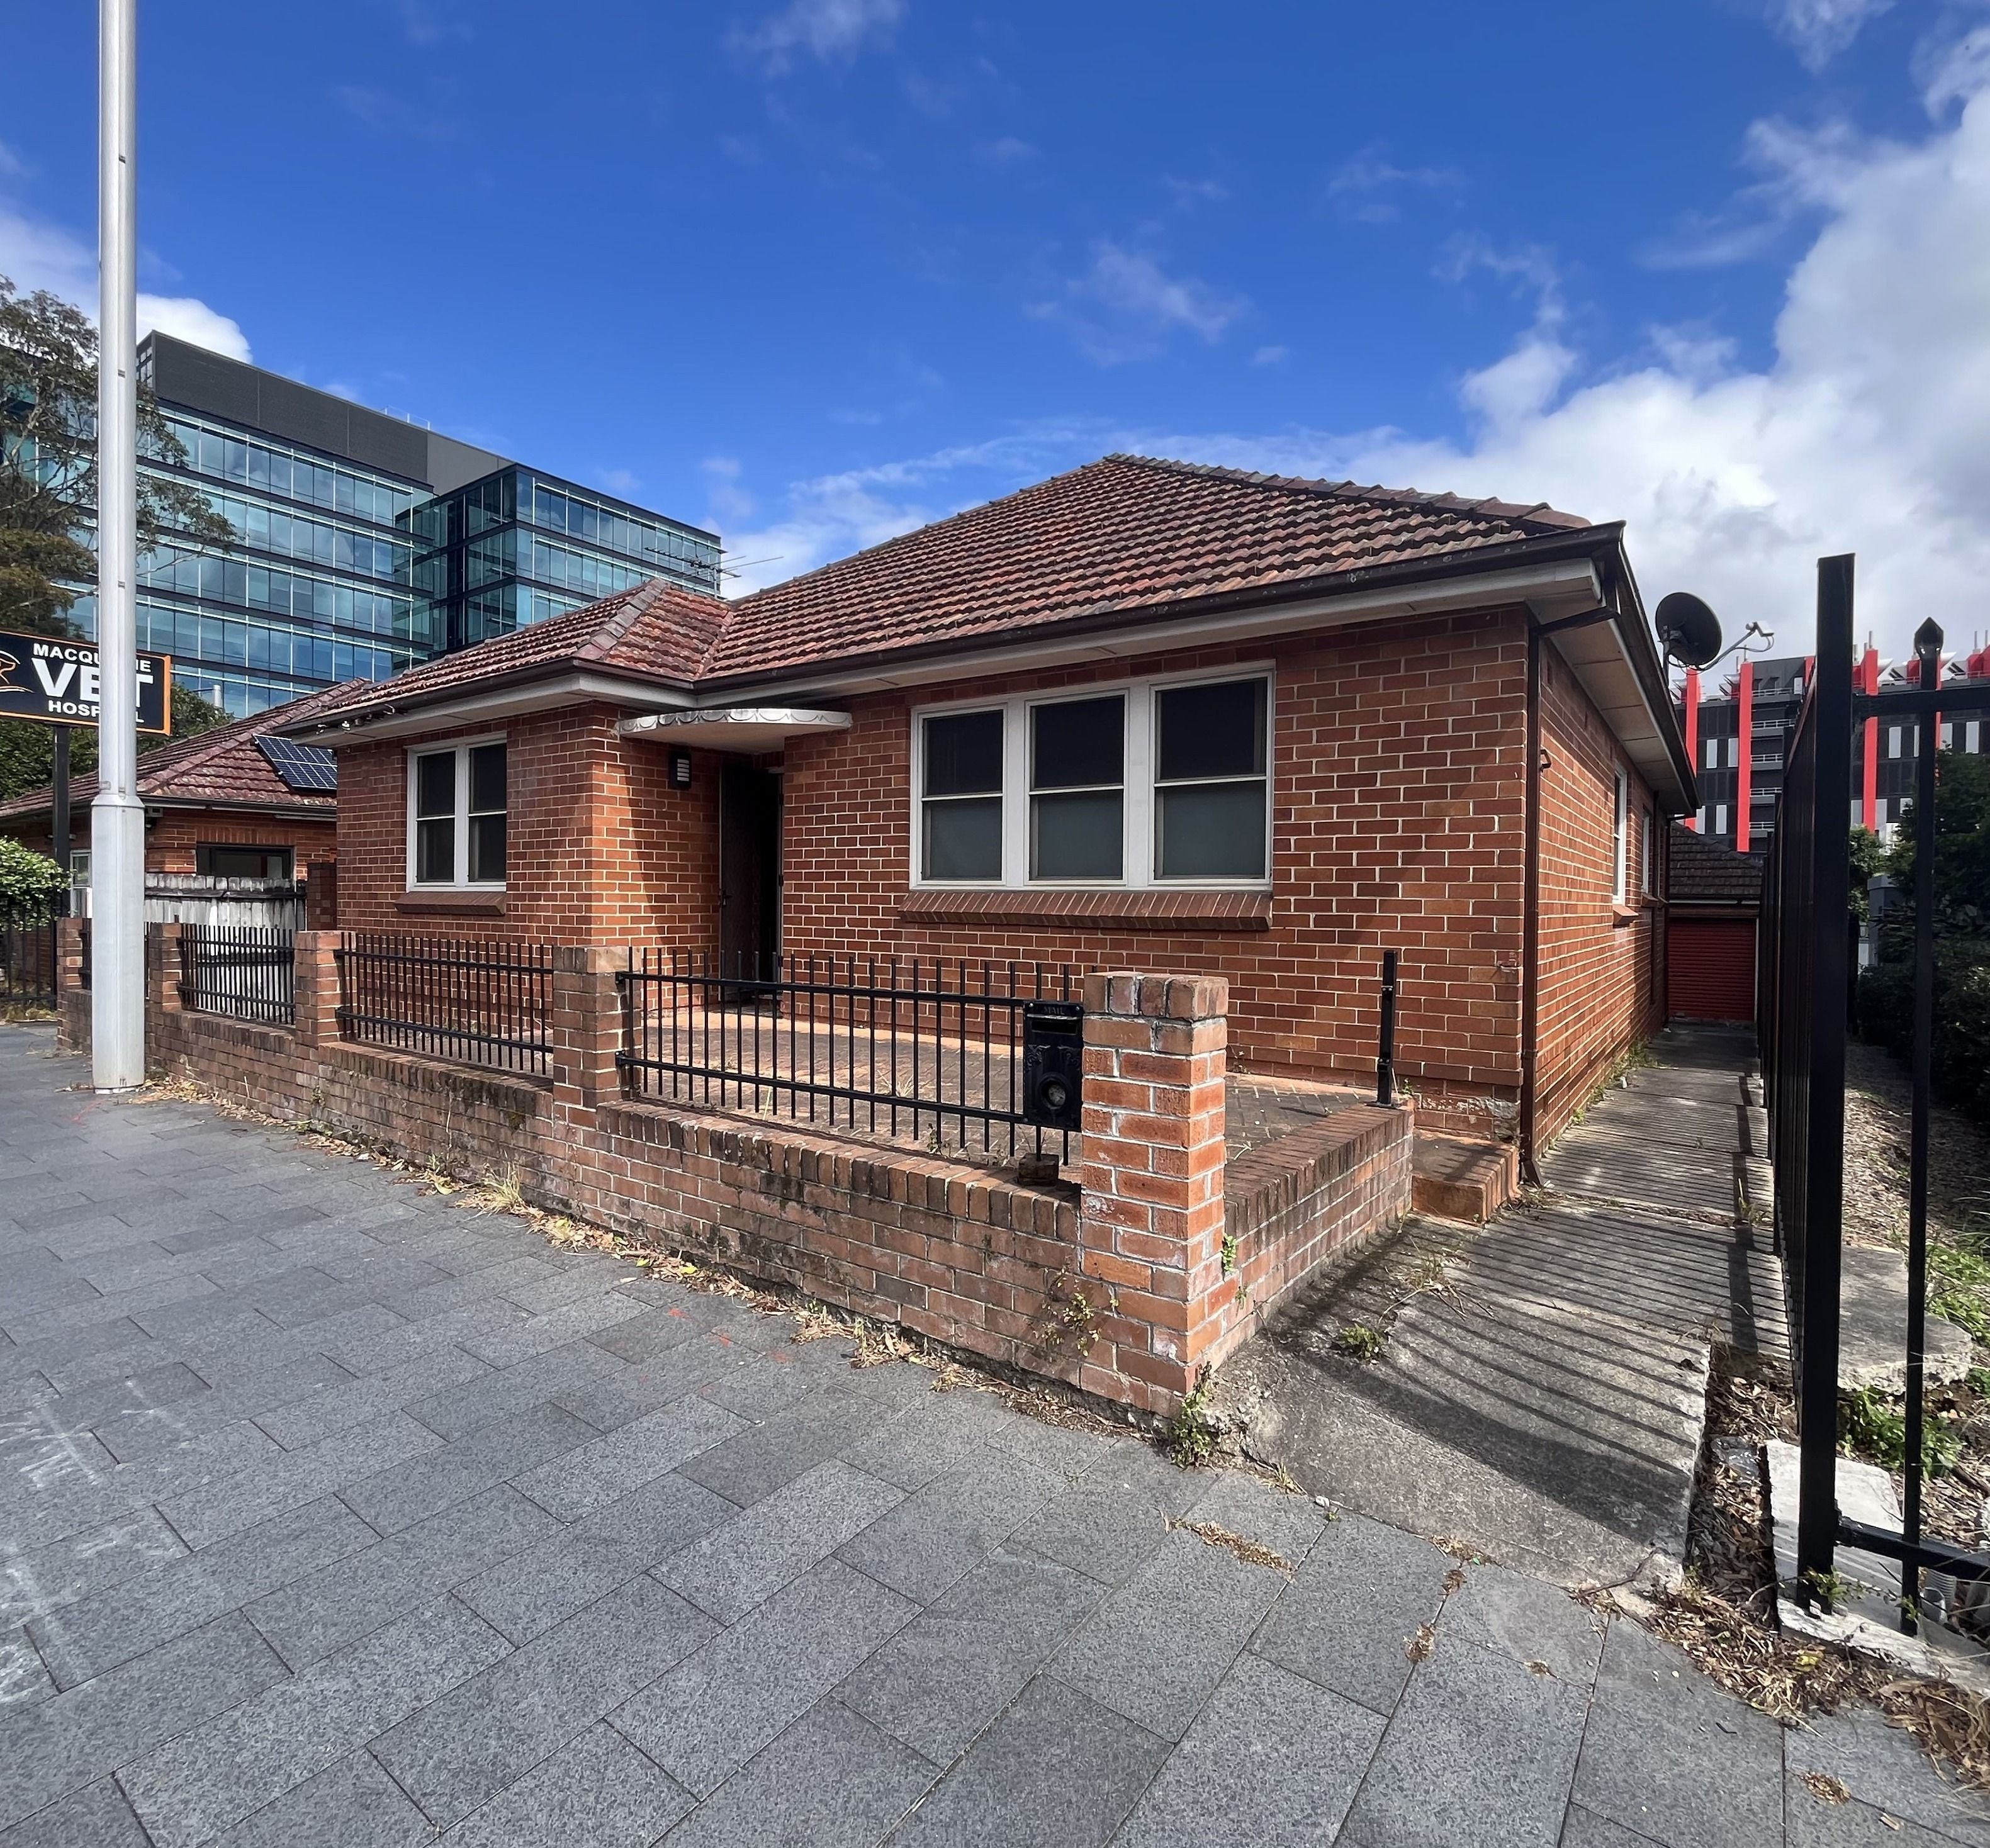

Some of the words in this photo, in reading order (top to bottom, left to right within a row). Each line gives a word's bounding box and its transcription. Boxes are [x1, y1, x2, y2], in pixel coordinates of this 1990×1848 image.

[33, 643, 152, 673] MACQIE
[48, 700, 145, 724] HOSPL
[1043, 1006, 1065, 1015] MAIL
